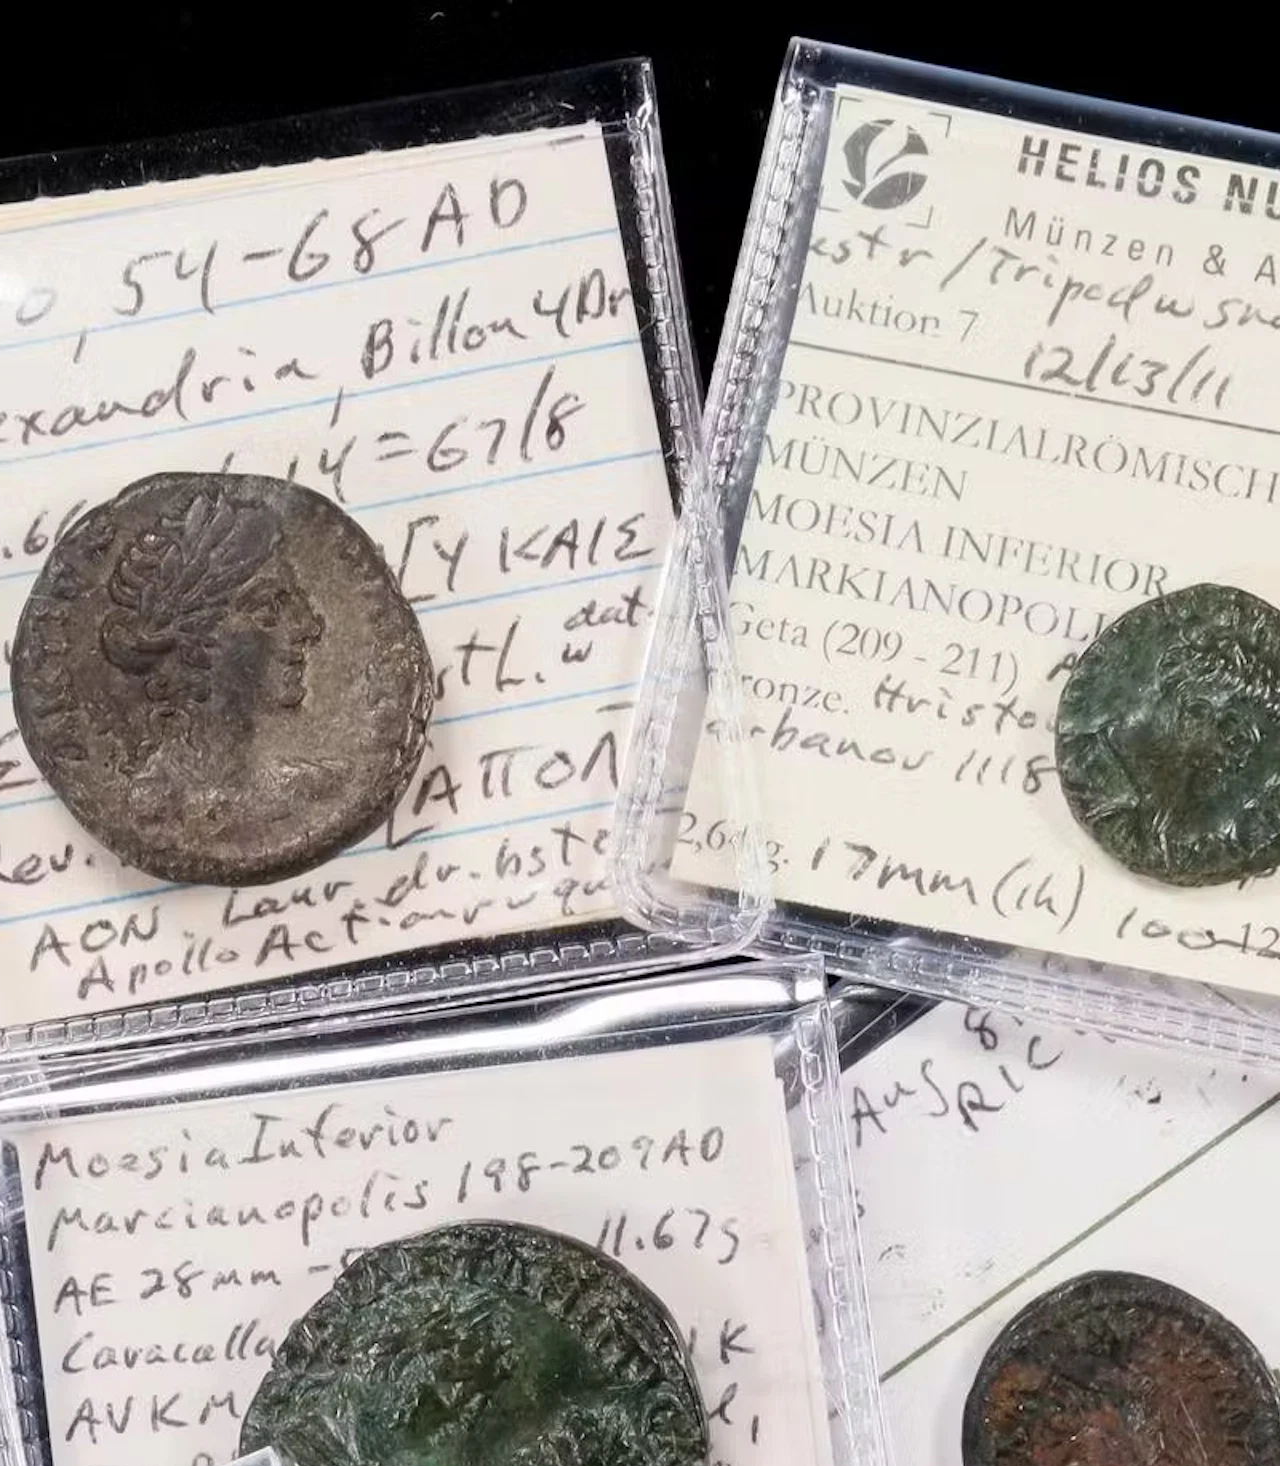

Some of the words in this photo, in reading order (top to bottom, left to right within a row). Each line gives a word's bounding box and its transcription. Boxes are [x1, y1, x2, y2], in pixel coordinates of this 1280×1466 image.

[1017, 135, 1200, 207] HELIOS
[1003, 207, 1176, 266] Münzen
[1202, 243, 1228, 277] &
[959, 309, 979, 342] 7
[1022, 335, 1233, 411] 12/13/11
[757, 432, 969, 502] MÜNZEN
[748, 486, 927, 558] MOESIA
[941, 523, 1169, 600] INFERIOR
[730, 600, 809, 648] Geta
